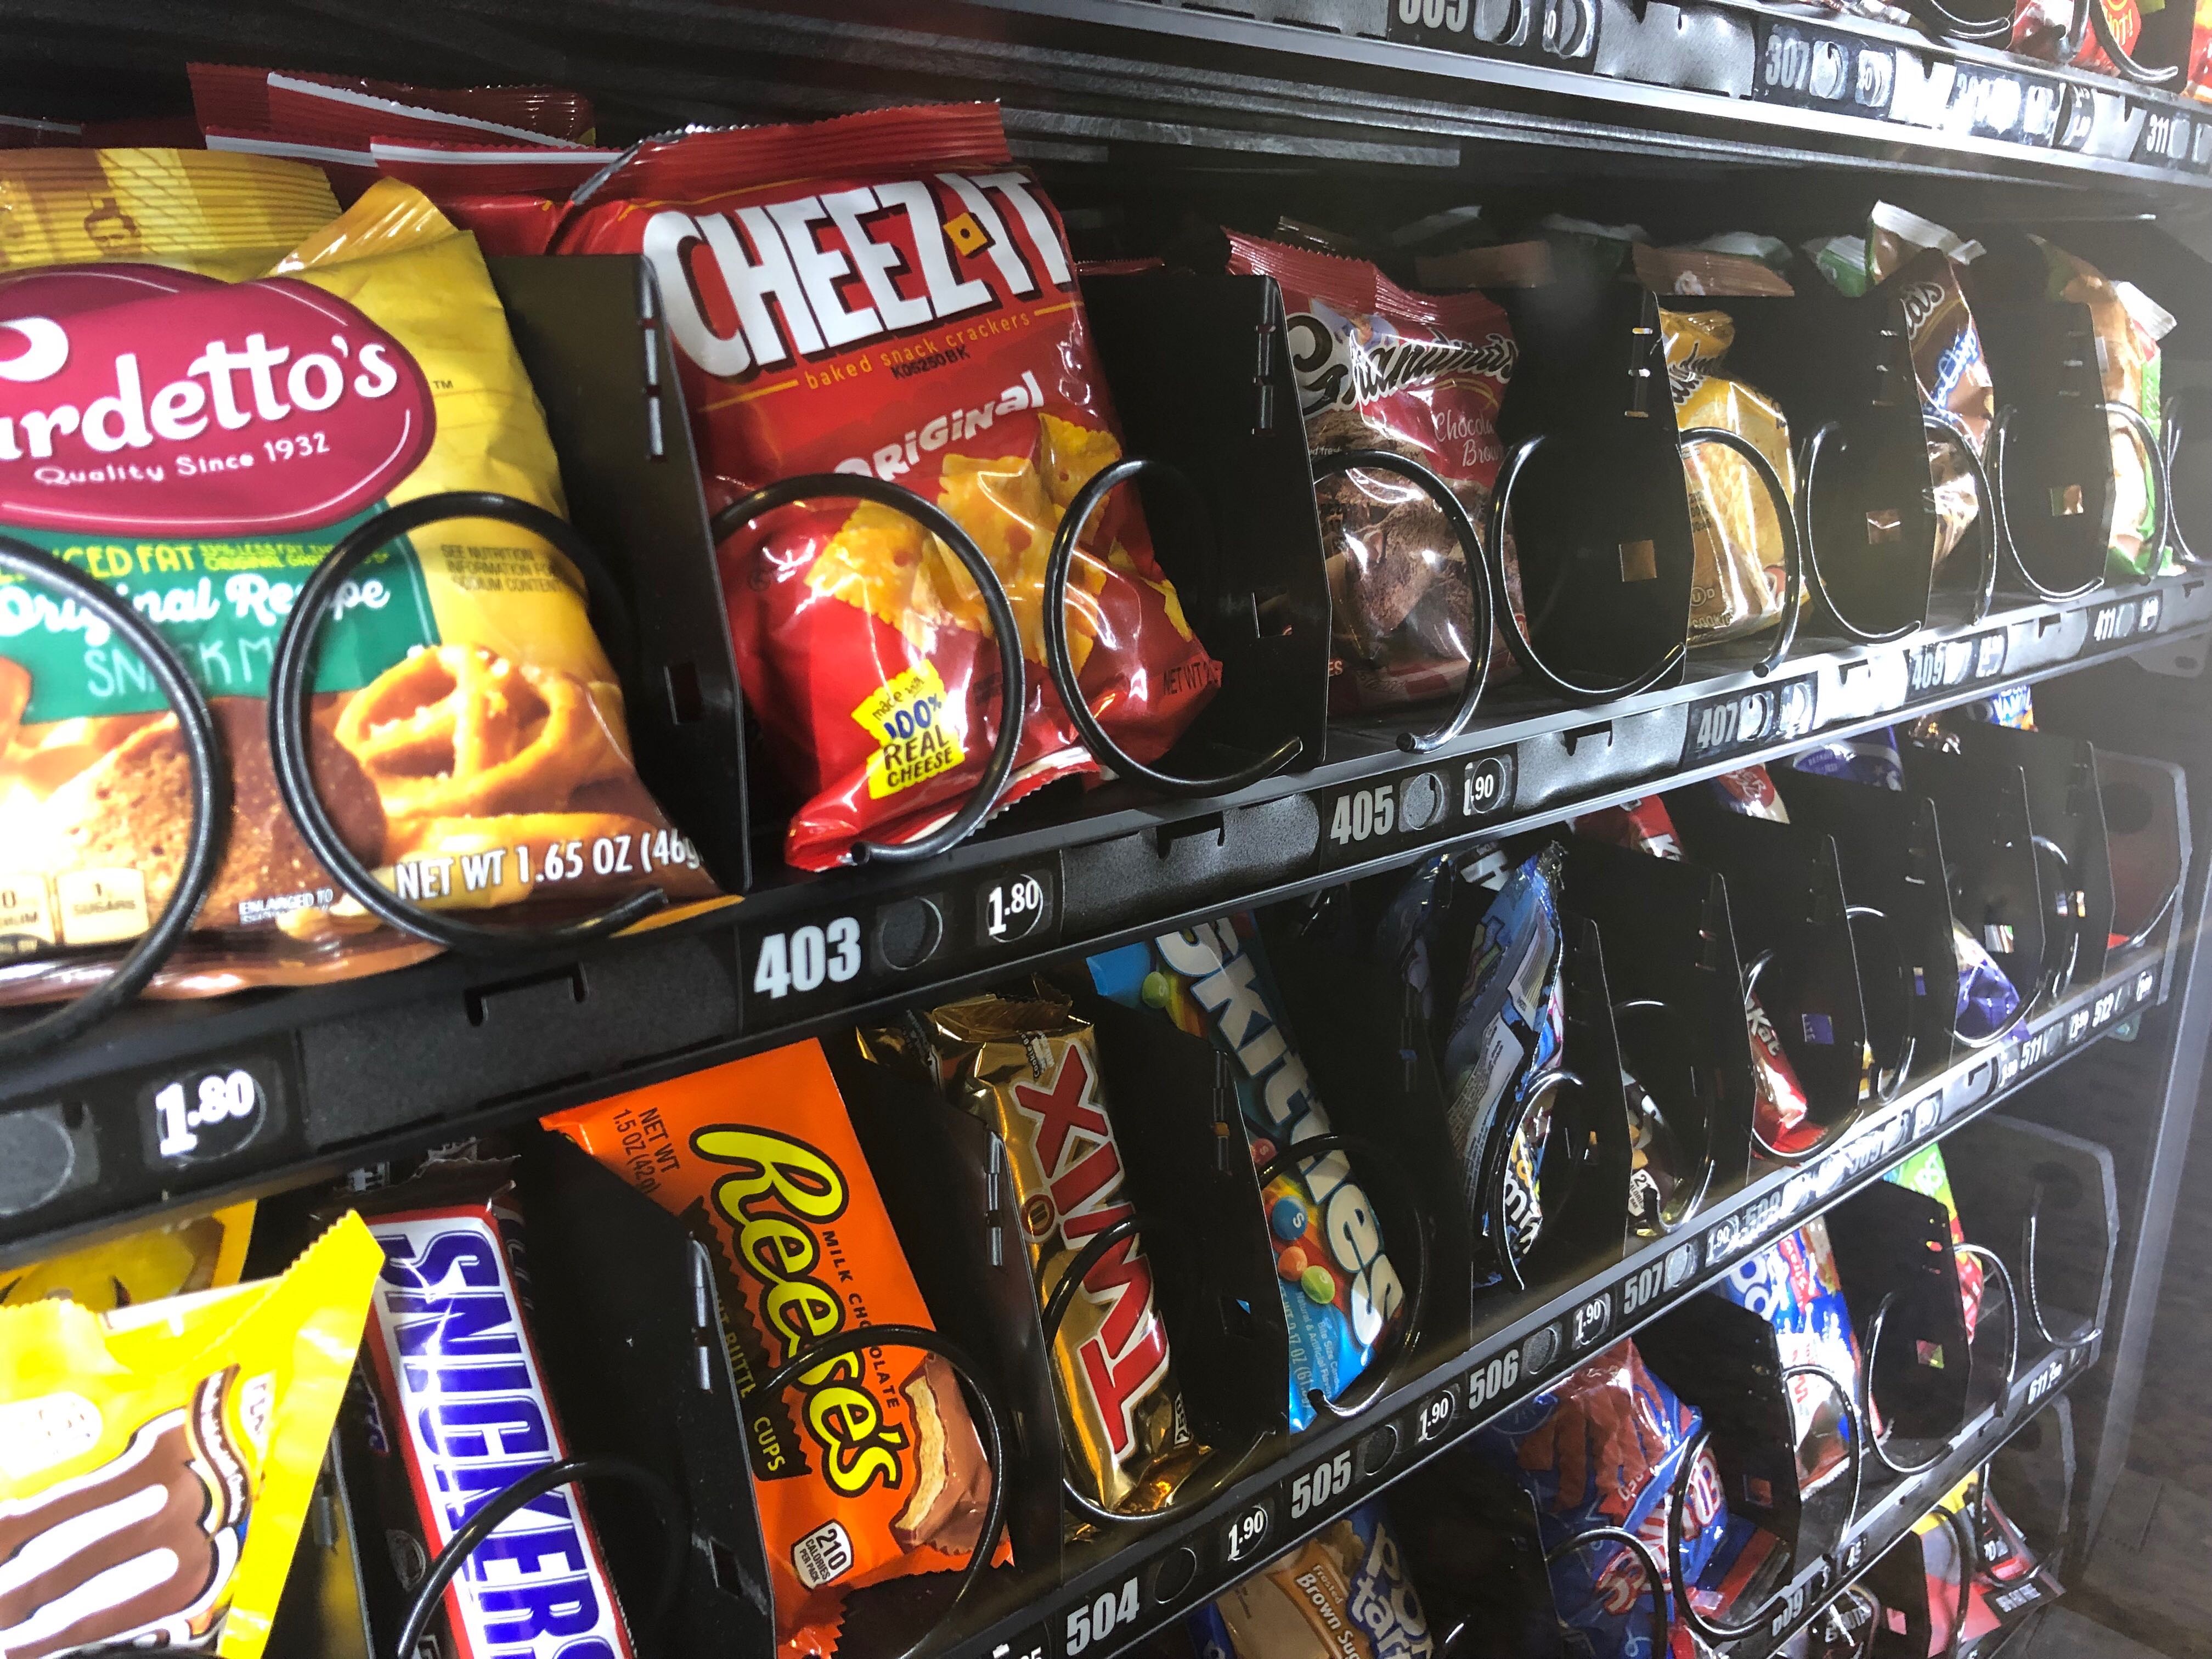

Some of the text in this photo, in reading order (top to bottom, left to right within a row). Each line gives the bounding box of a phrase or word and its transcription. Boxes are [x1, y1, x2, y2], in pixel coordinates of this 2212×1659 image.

[1765, 35, 1810, 91] 307
[804, 312, 1030, 390] baked snack crackers
[34, 432, 330, 486] Quality Since 1932
[136, 543, 196, 572] FAT
[0, 573, 391, 646] Orignal Repe
[1163, 667, 1183, 696] NET
[1183, 662, 1203, 690] WT
[883, 724, 950, 771] REAL
[1696, 701, 1739, 749] 407
[887, 746, 953, 787] CHEESE
[1329, 785, 1394, 845] 405
[396, 856, 453, 901] NET
[461, 848, 507, 890] WT
[516, 840, 583, 883] 1.65
[592, 834, 633, 874] OZ
[753, 879, 1040, 1000] 403 1.80
[155, 1070, 256, 1158] 1.80
[613, 1108, 636, 1133] 1.5
[638, 1107, 680, 1173] NET WT
[622, 1132, 646, 1155] OZ
[691, 1126, 907, 1495] Reese's
[821, 1229, 901, 1410] MILK CHOOLATE
[1295, 1291, 1312, 1323] Natural
[1575, 1261, 1664, 1342] 1.90 507
[1417, 1349, 1520, 1443] 1.90 506
[378, 1231, 613, 1659] SNICKER
[753, 1416, 786, 1471] CUPS
[1227, 1450, 1352, 1561] 1.90 505
[799, 1548, 820, 1583] PER PACK
[805, 1538, 831, 1580] CALORIES
[815, 1528, 847, 1571] 210
[1295, 1573, 1342, 1631] Brown
[1313, 1564, 1344, 1604] Frosted
[1066, 1577, 1140, 1657] 504
